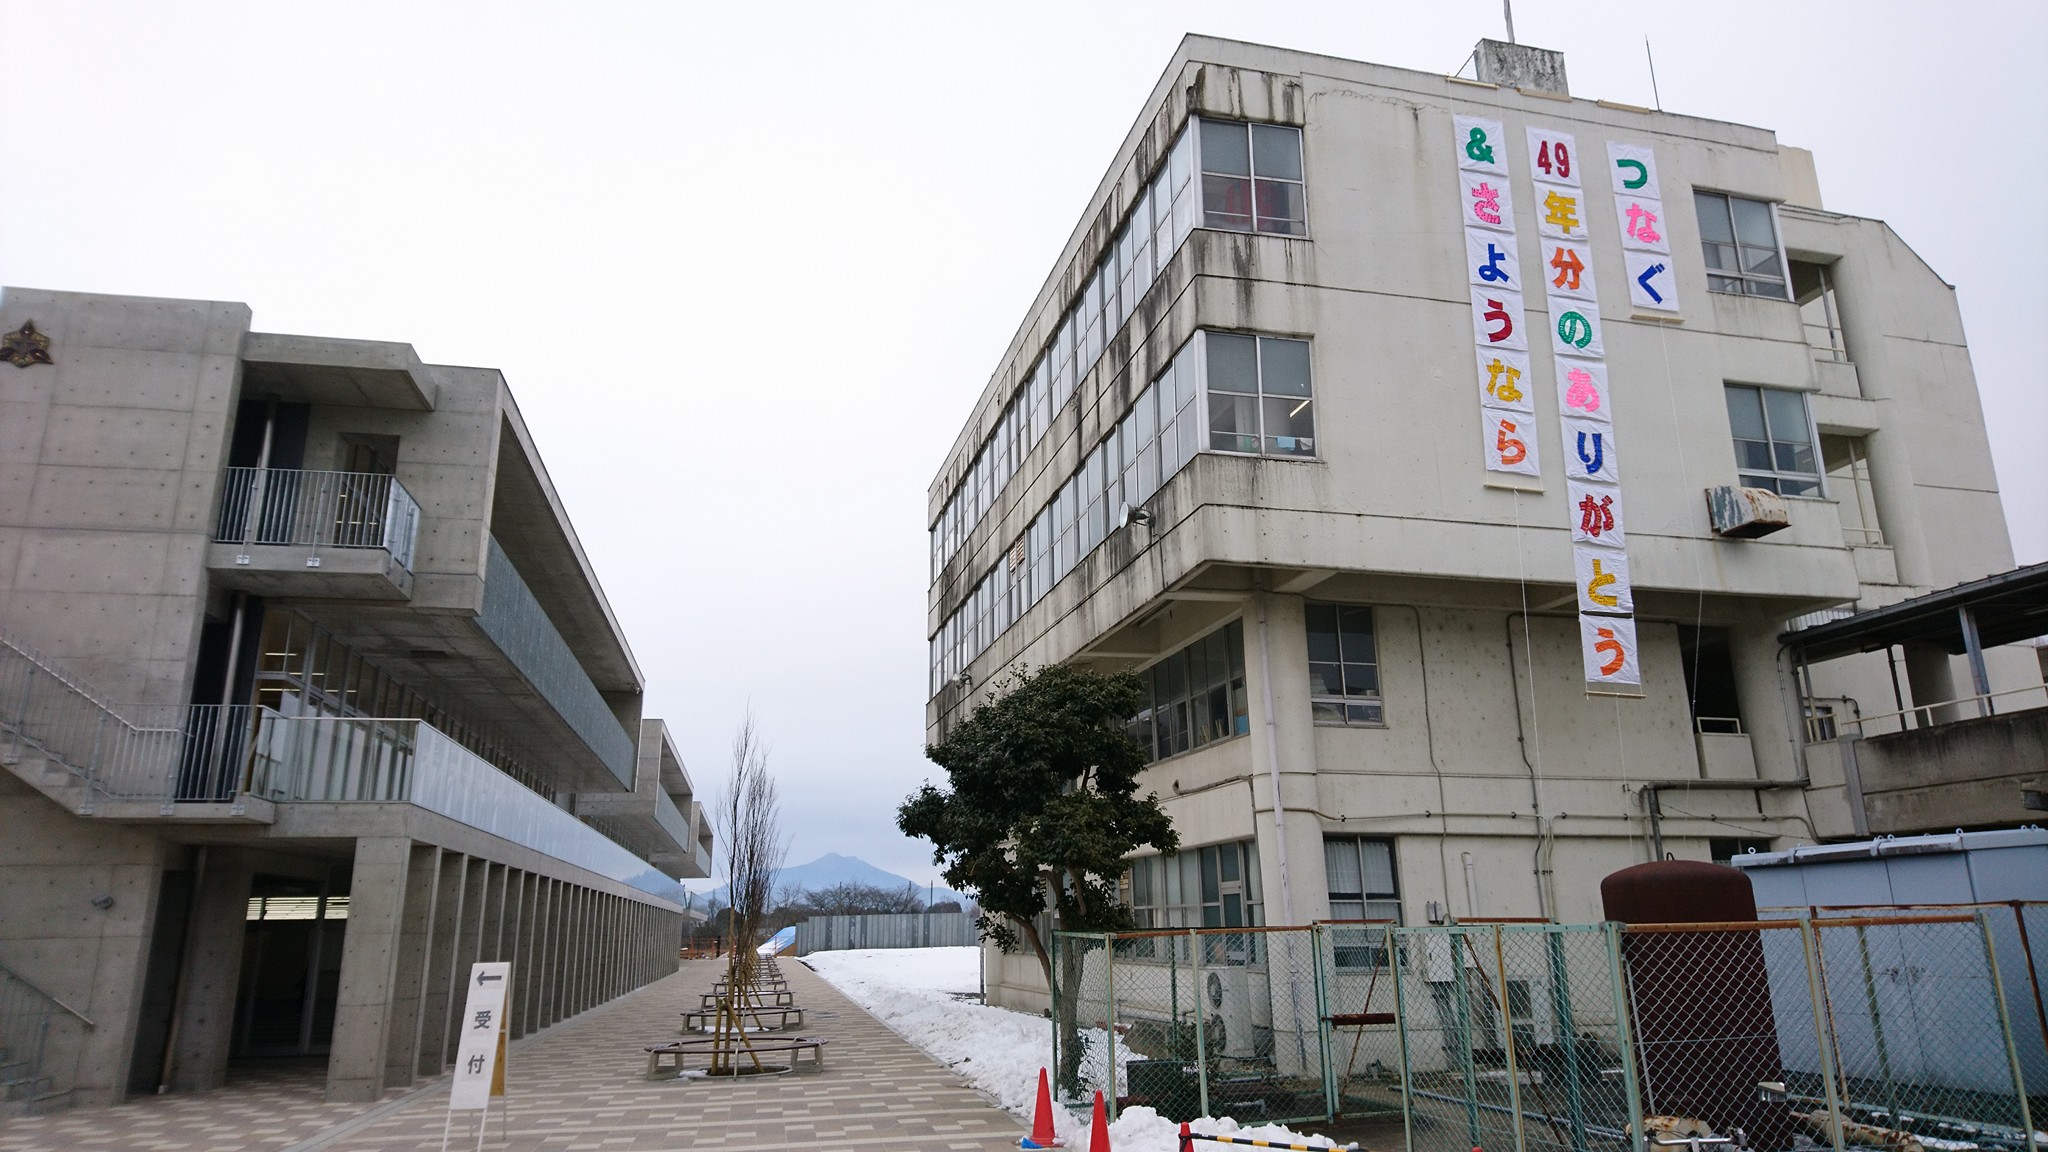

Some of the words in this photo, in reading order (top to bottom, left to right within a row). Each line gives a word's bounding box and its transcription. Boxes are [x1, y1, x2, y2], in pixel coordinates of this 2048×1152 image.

[1465, 127, 1526, 465] &さようなら
[1617, 158, 1663, 304] つなぐ
[1537, 140, 1624, 676] 49年分のありがとう
[467, 1010, 492, 1074] 受付
